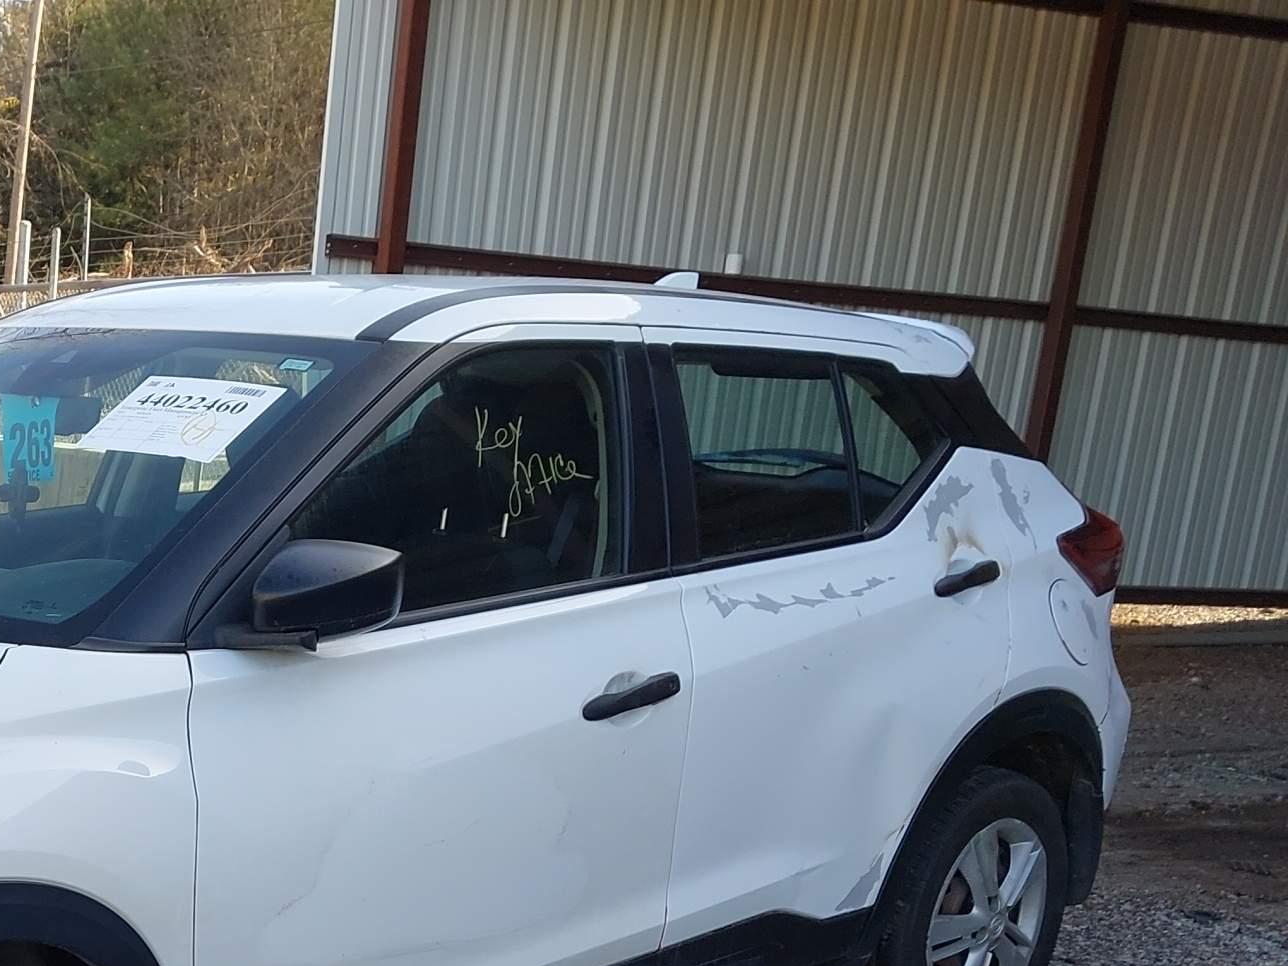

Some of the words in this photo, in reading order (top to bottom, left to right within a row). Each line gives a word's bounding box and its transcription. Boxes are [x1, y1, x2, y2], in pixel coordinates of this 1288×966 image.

[136, 392, 249, 415] 44022460
[9, 418, 52, 469] 263
[475, 405, 523, 482] Key
[7, 469, 41, 482] SICE
